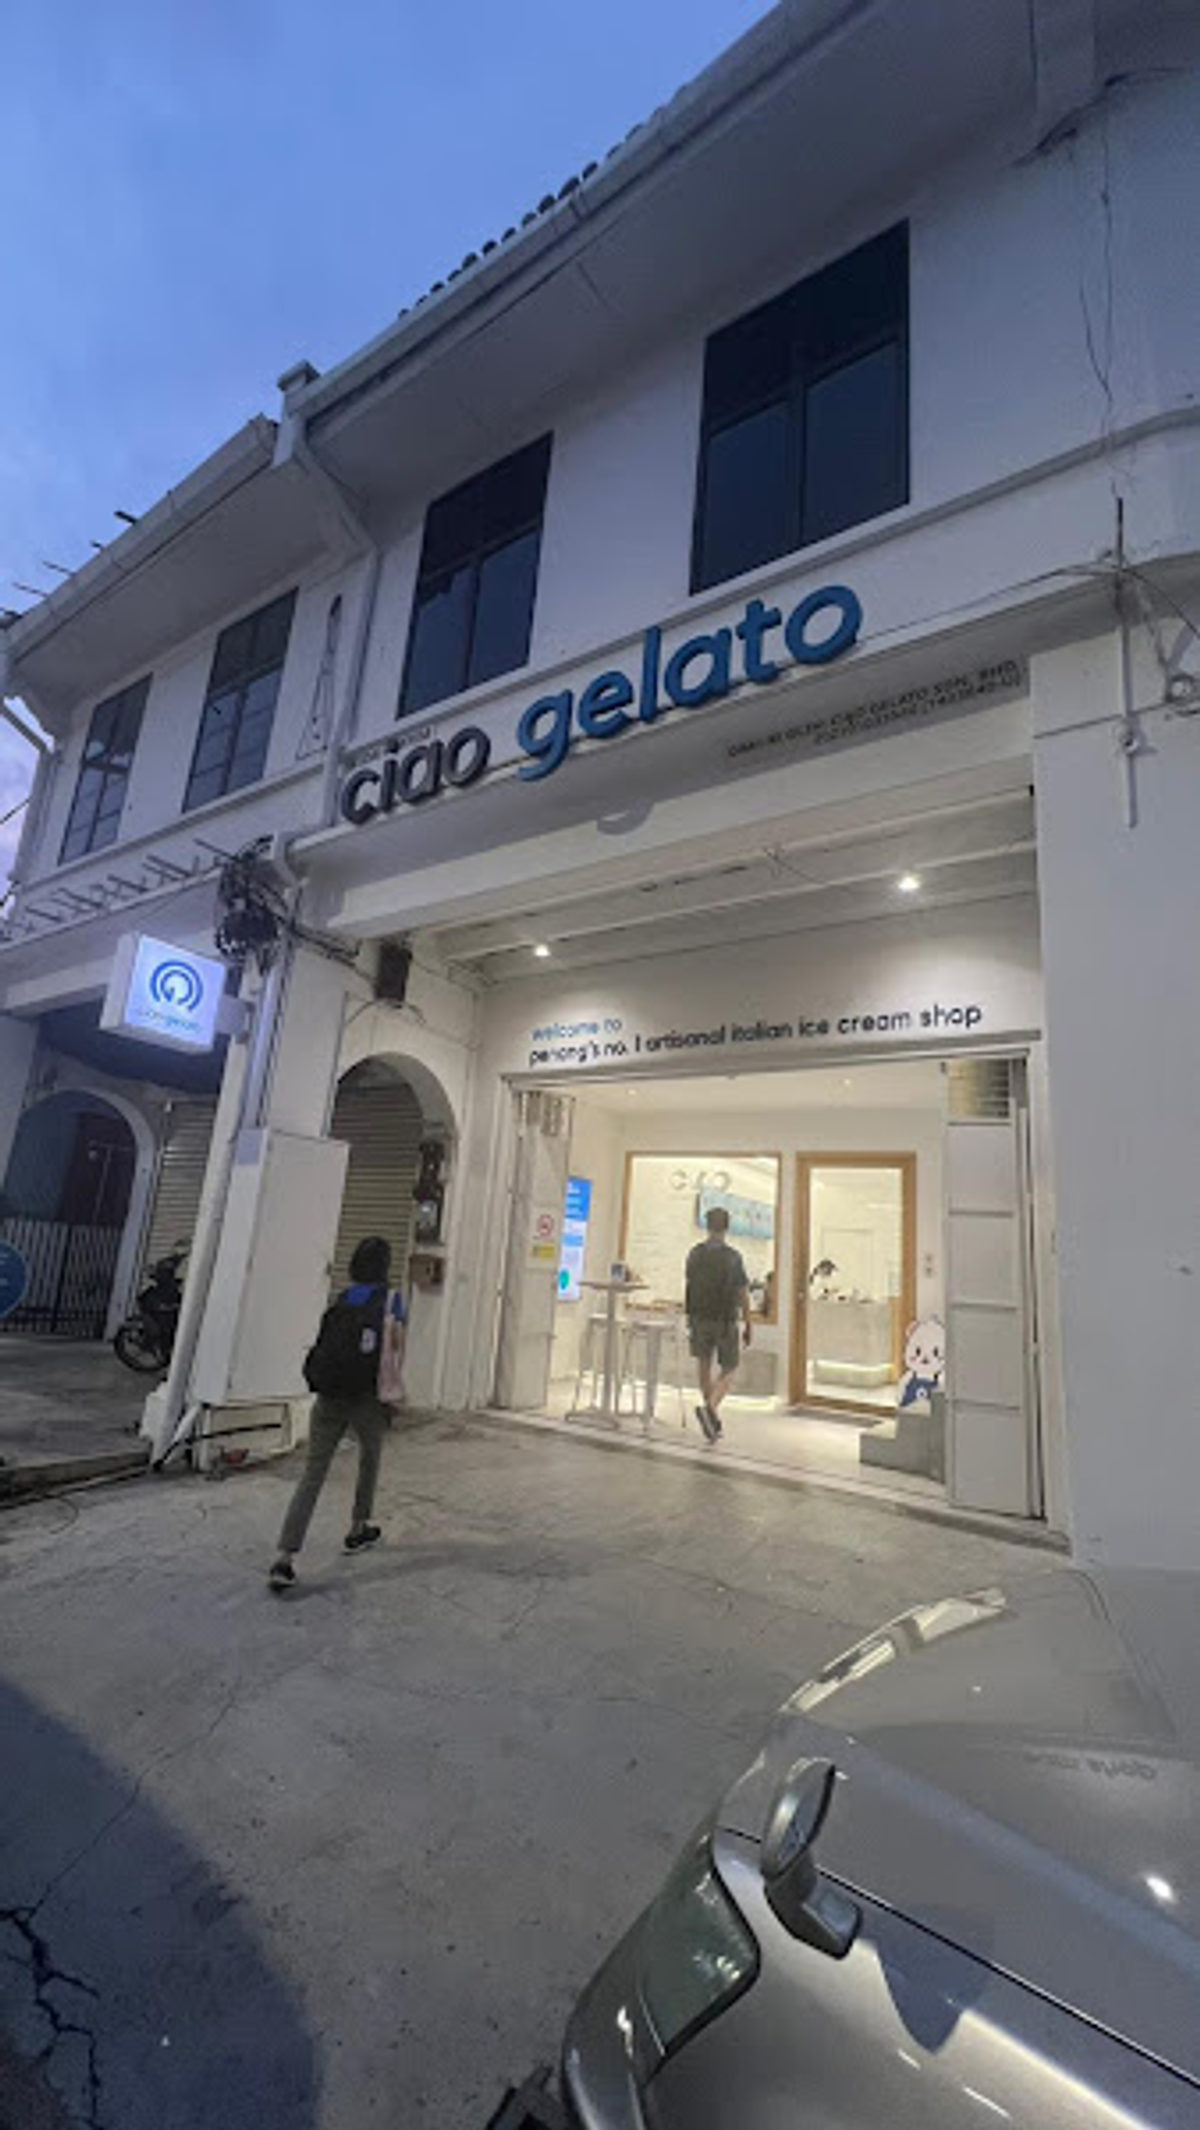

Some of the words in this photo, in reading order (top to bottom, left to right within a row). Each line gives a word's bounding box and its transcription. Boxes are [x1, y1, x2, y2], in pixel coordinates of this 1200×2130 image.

[341, 727, 491, 824] ciao
[517, 585, 862, 781] gelato
[530, 1022, 598, 1040] welcome
[646, 1024, 725, 1051] artisanal
[732, 1019, 793, 1042] italian
[798, 1015, 830, 1036] ice
[837, 1012, 912, 1034] cream
[920, 1004, 982, 1029] shop
